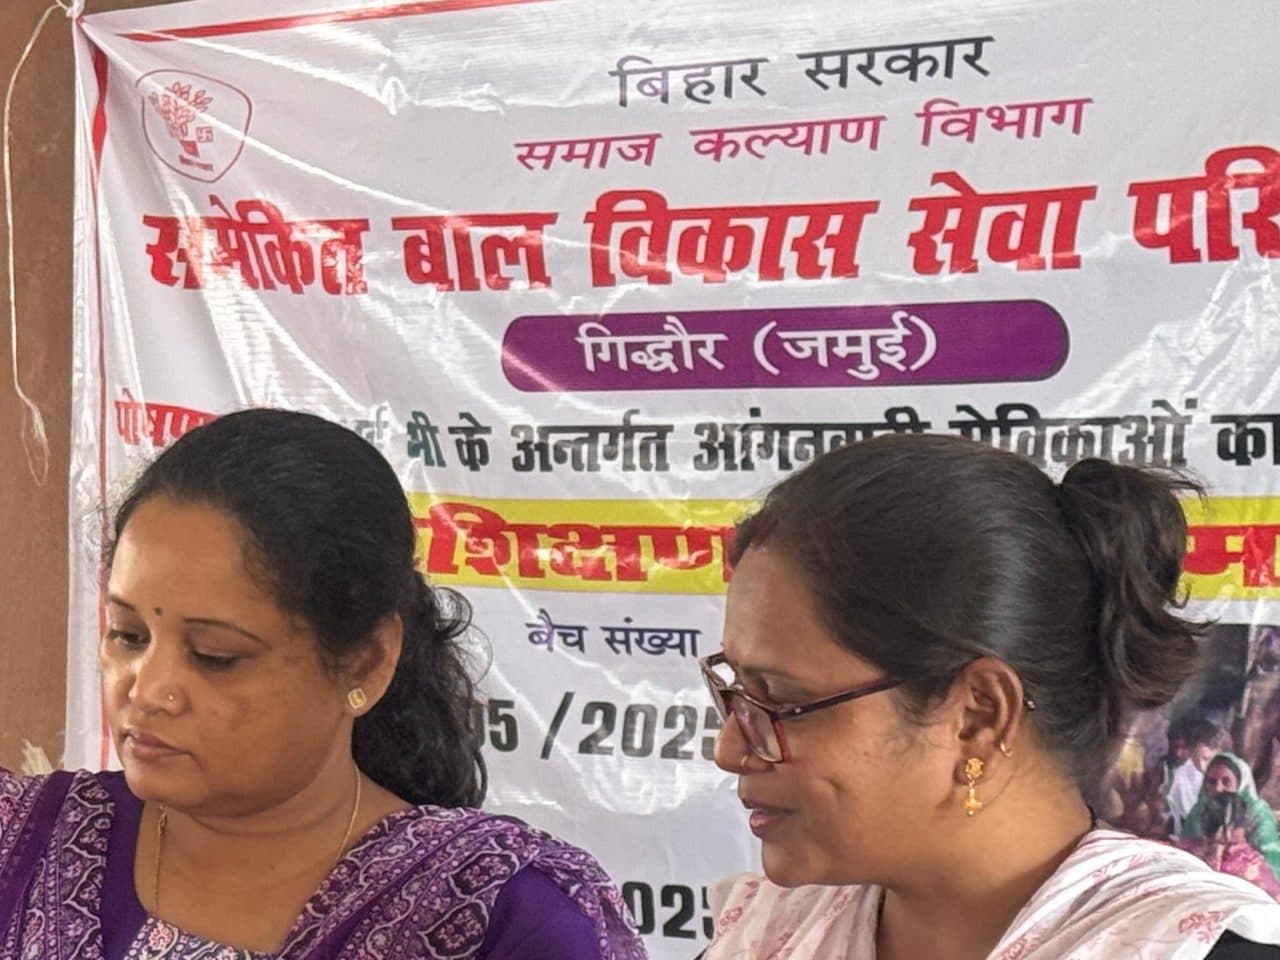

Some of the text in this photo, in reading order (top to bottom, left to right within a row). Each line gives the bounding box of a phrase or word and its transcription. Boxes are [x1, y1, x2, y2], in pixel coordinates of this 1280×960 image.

[608, 36, 995, 107] बिहार सरकार
[514, 98, 1094, 170] समाज कल्याण विभाग
[142, 193, 370, 295] समेकित
[392, 211, 559, 294] बाल
[583, 189, 880, 286] विकास
[906, 171, 1098, 277] सेवा
[576, 310, 937, 381] गिद्धौर (जमुई)
[448, 412, 492, 472] के
[512, 410, 674, 473] अन्तर्गत
[414, 502, 736, 582] शिक्षण
[525, 608, 701, 656] बैच संख्या
